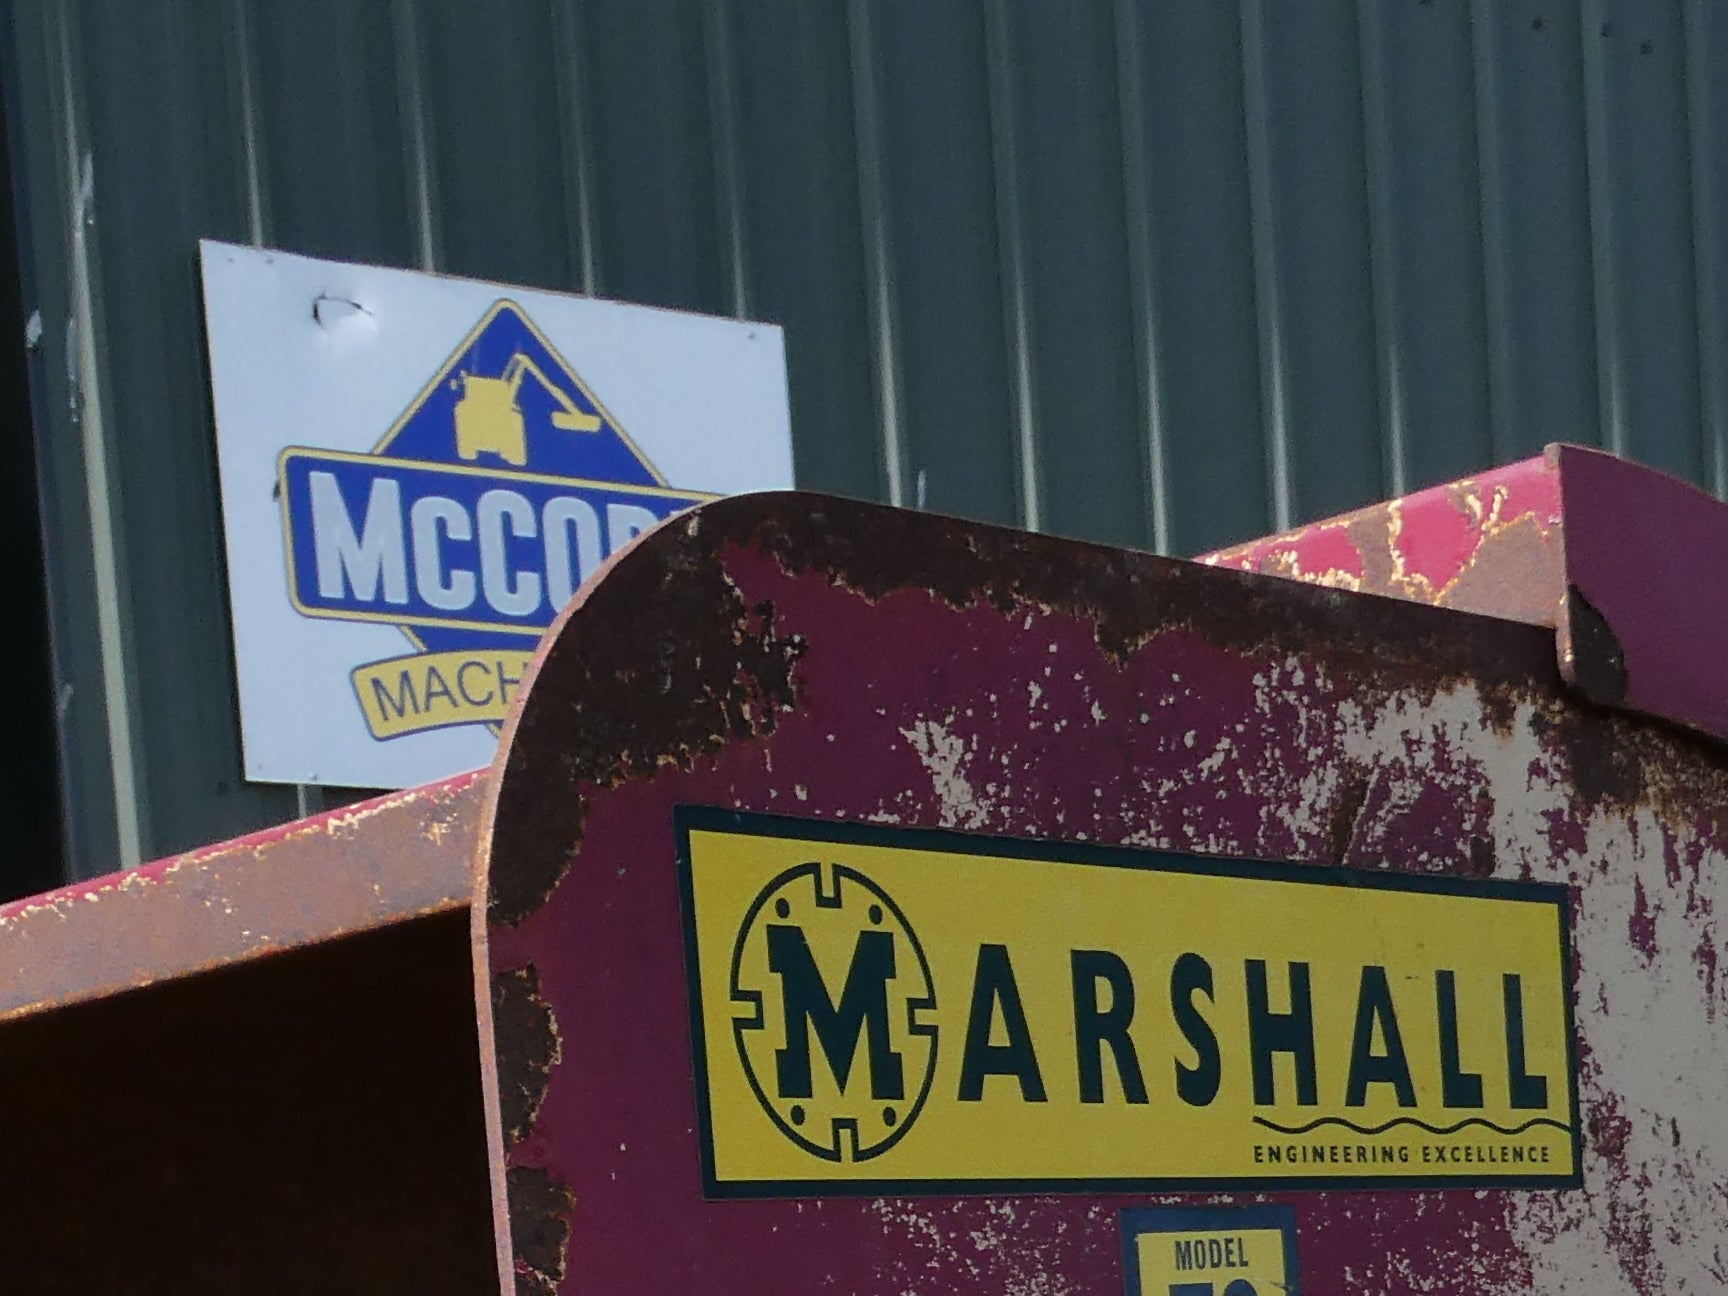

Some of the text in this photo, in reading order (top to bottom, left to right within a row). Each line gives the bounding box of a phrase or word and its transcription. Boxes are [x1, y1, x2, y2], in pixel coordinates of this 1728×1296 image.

[766, 924, 1548, 1109] MARSHALL
[1253, 1145, 1550, 1164] ENGINEERING EXCELLENCE
[1175, 1238, 1249, 1270] MODEL
